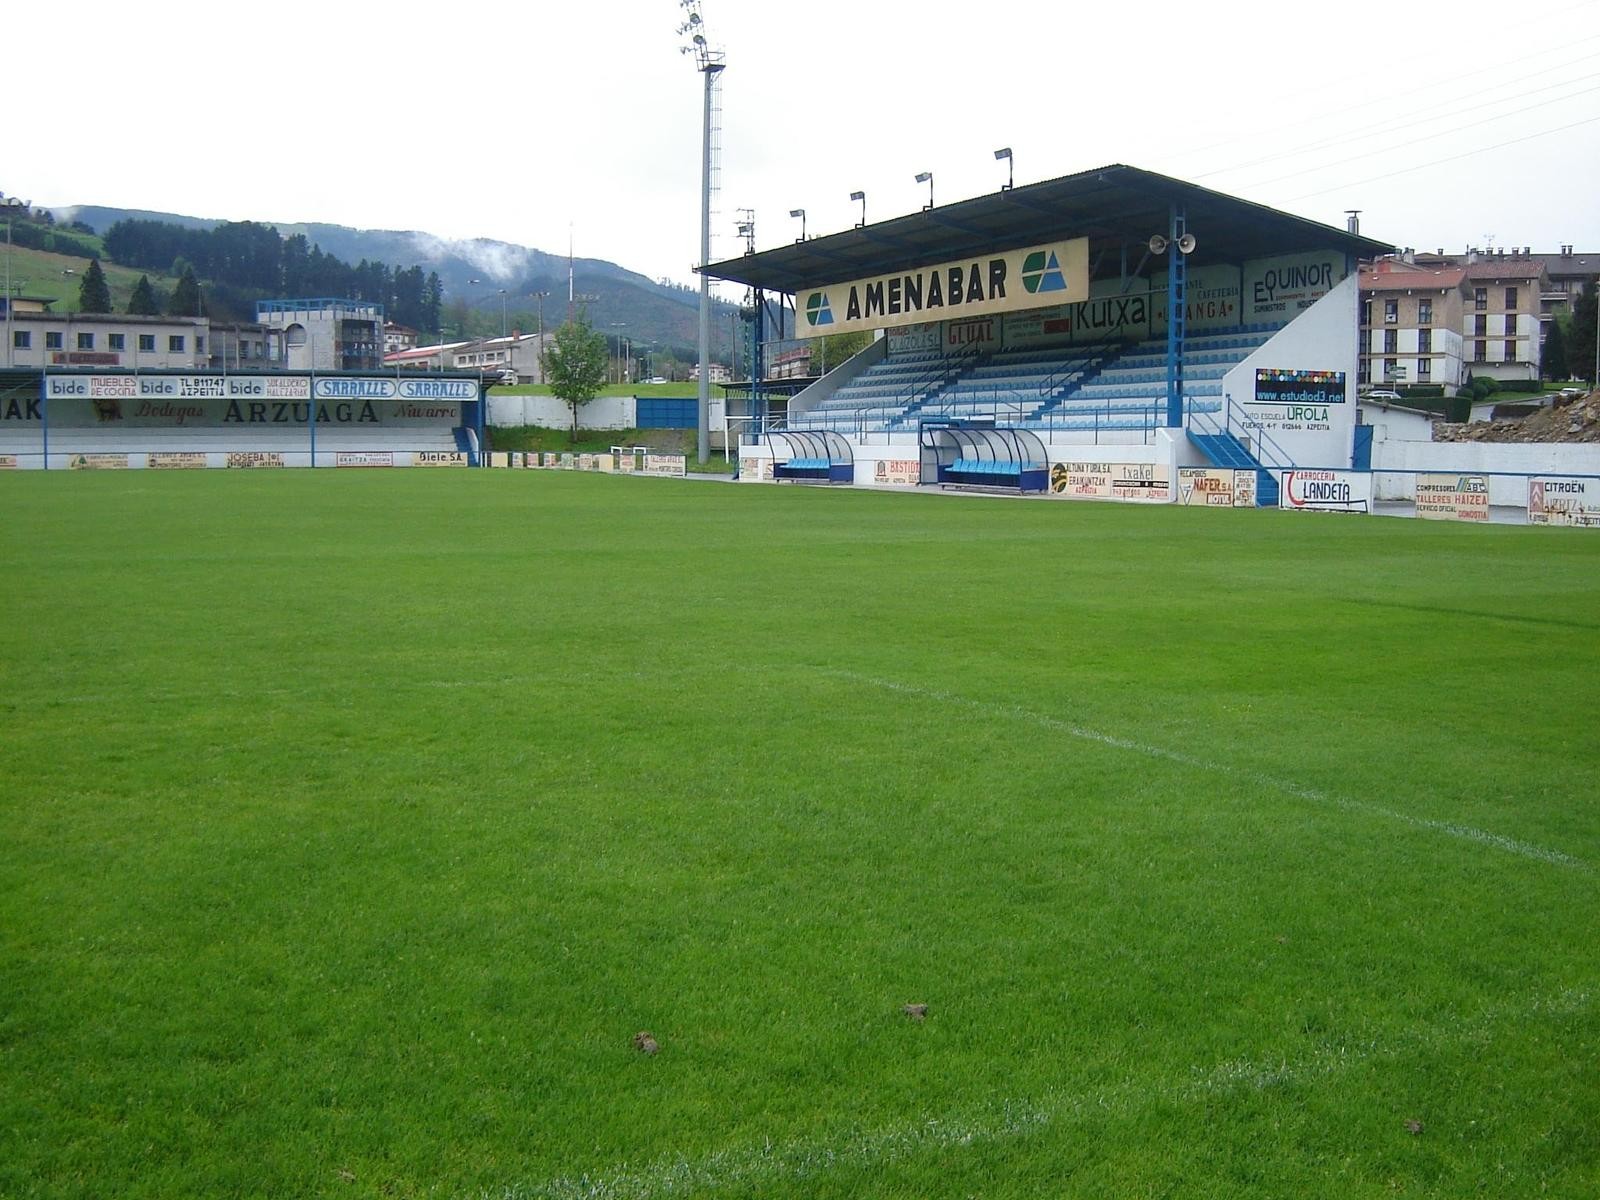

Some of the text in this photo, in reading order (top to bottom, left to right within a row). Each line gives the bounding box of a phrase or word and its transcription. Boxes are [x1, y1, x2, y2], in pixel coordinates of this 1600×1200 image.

[845, 258, 1007, 321] AMENABAR
[1254, 263, 1333, 302] EQUINOR
[1163, 301, 1227, 322] UANGA
[53, 380, 85, 395] bide
[91, 378, 137, 387] MUEBLES
[141, 380, 173, 395] bide
[230, 380, 262, 395] bide
[1257, 390, 1344, 403] www.estudiod3.net
[0, 398, 43, 420] AK
[136, 401, 204, 424] Bodegas
[224, 399, 379, 423] ARZUAGA
[1287, 406, 1329, 422] UROLA
[1303, 481, 1350, 502] LANDETA
[1544, 480, 1585, 493] CITROËN
[1416, 494, 1488, 505] TALLERES HAIZEA
